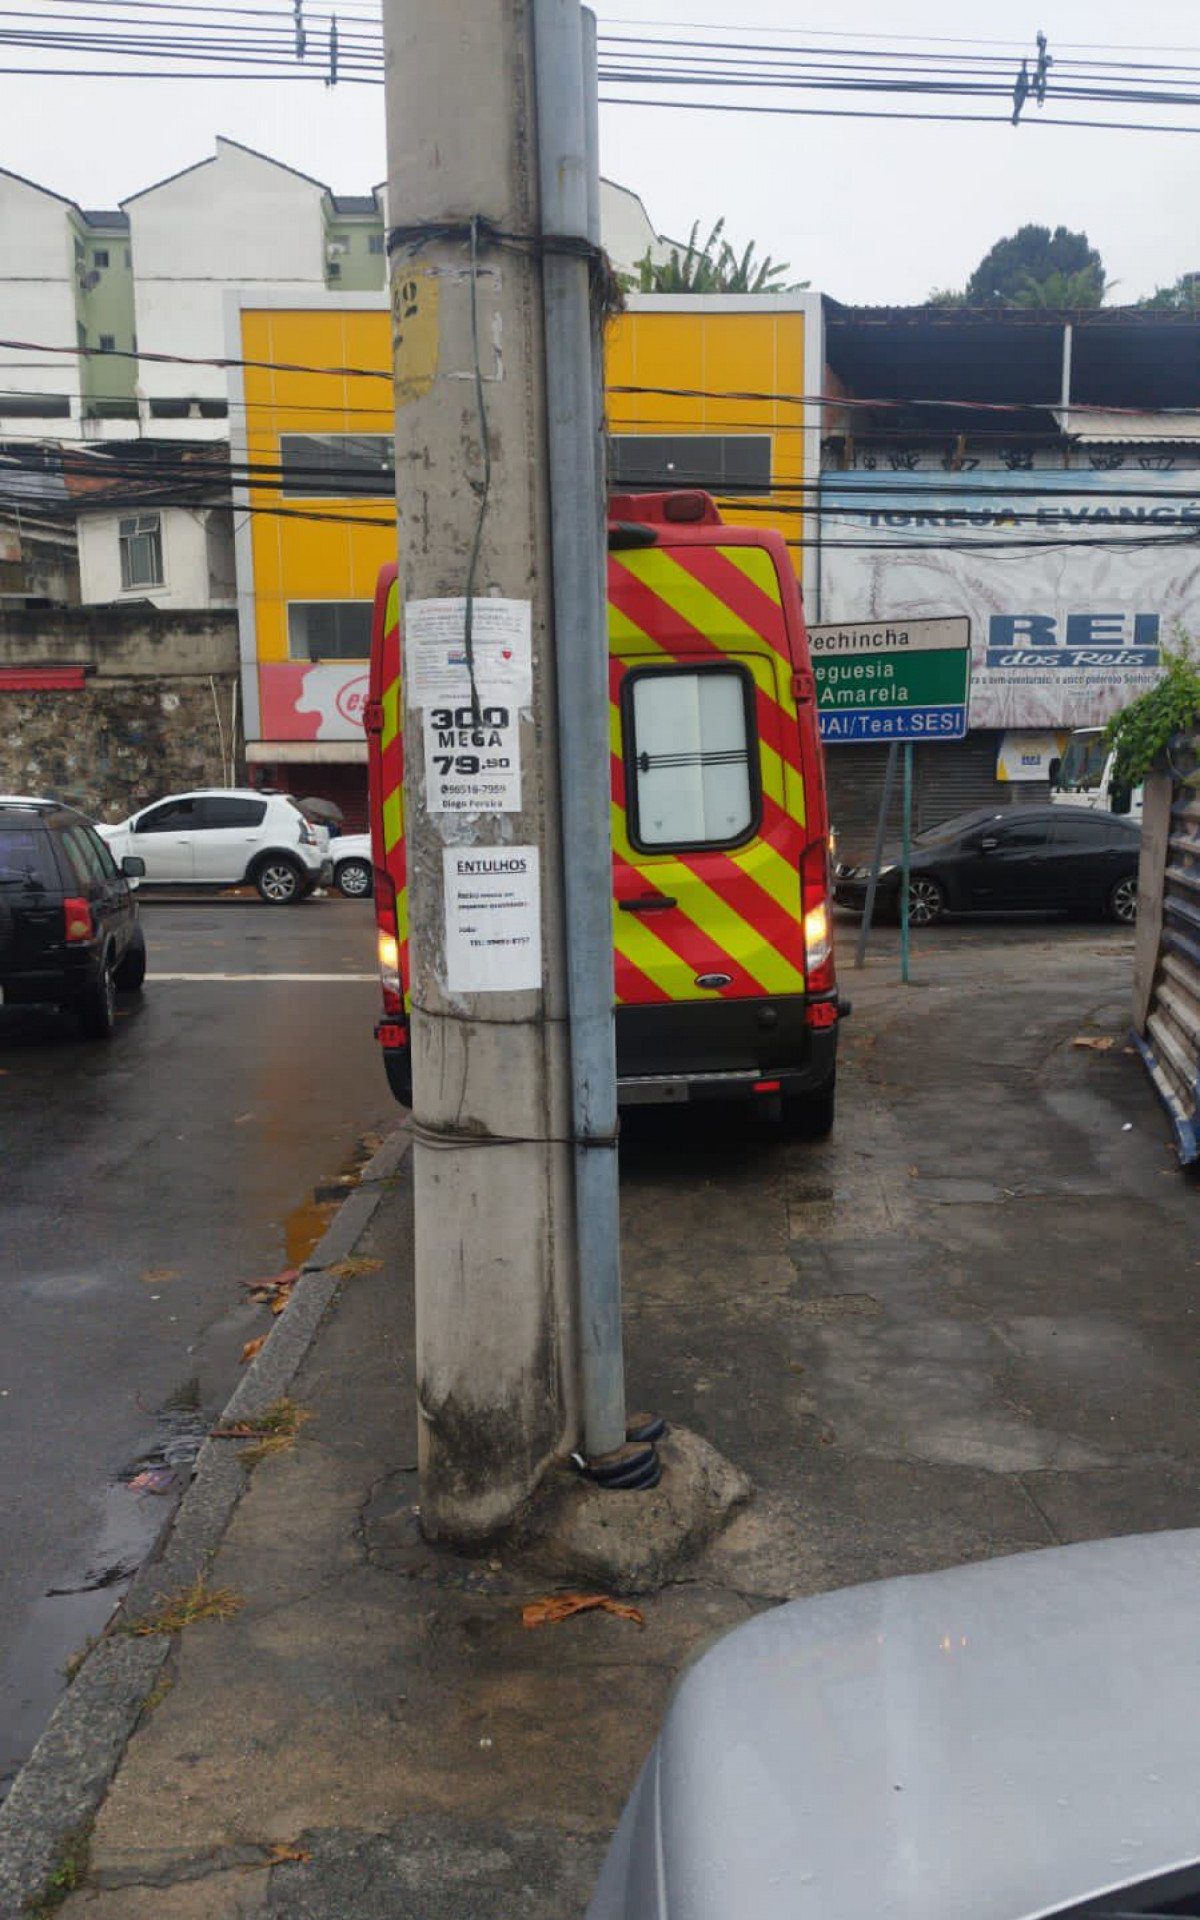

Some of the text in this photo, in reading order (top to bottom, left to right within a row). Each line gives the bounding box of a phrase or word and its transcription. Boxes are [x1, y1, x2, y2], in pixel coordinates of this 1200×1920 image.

[988, 614, 1160, 646] REI
[999, 649, 1145, 667] dos Reis
[812, 660, 895, 684] eguesia
[821, 682, 909, 704] Amarela
[430, 706, 509, 730] 300
[438, 731, 503, 748] MEGA
[457, 858, 527, 873] ENTULHOS
